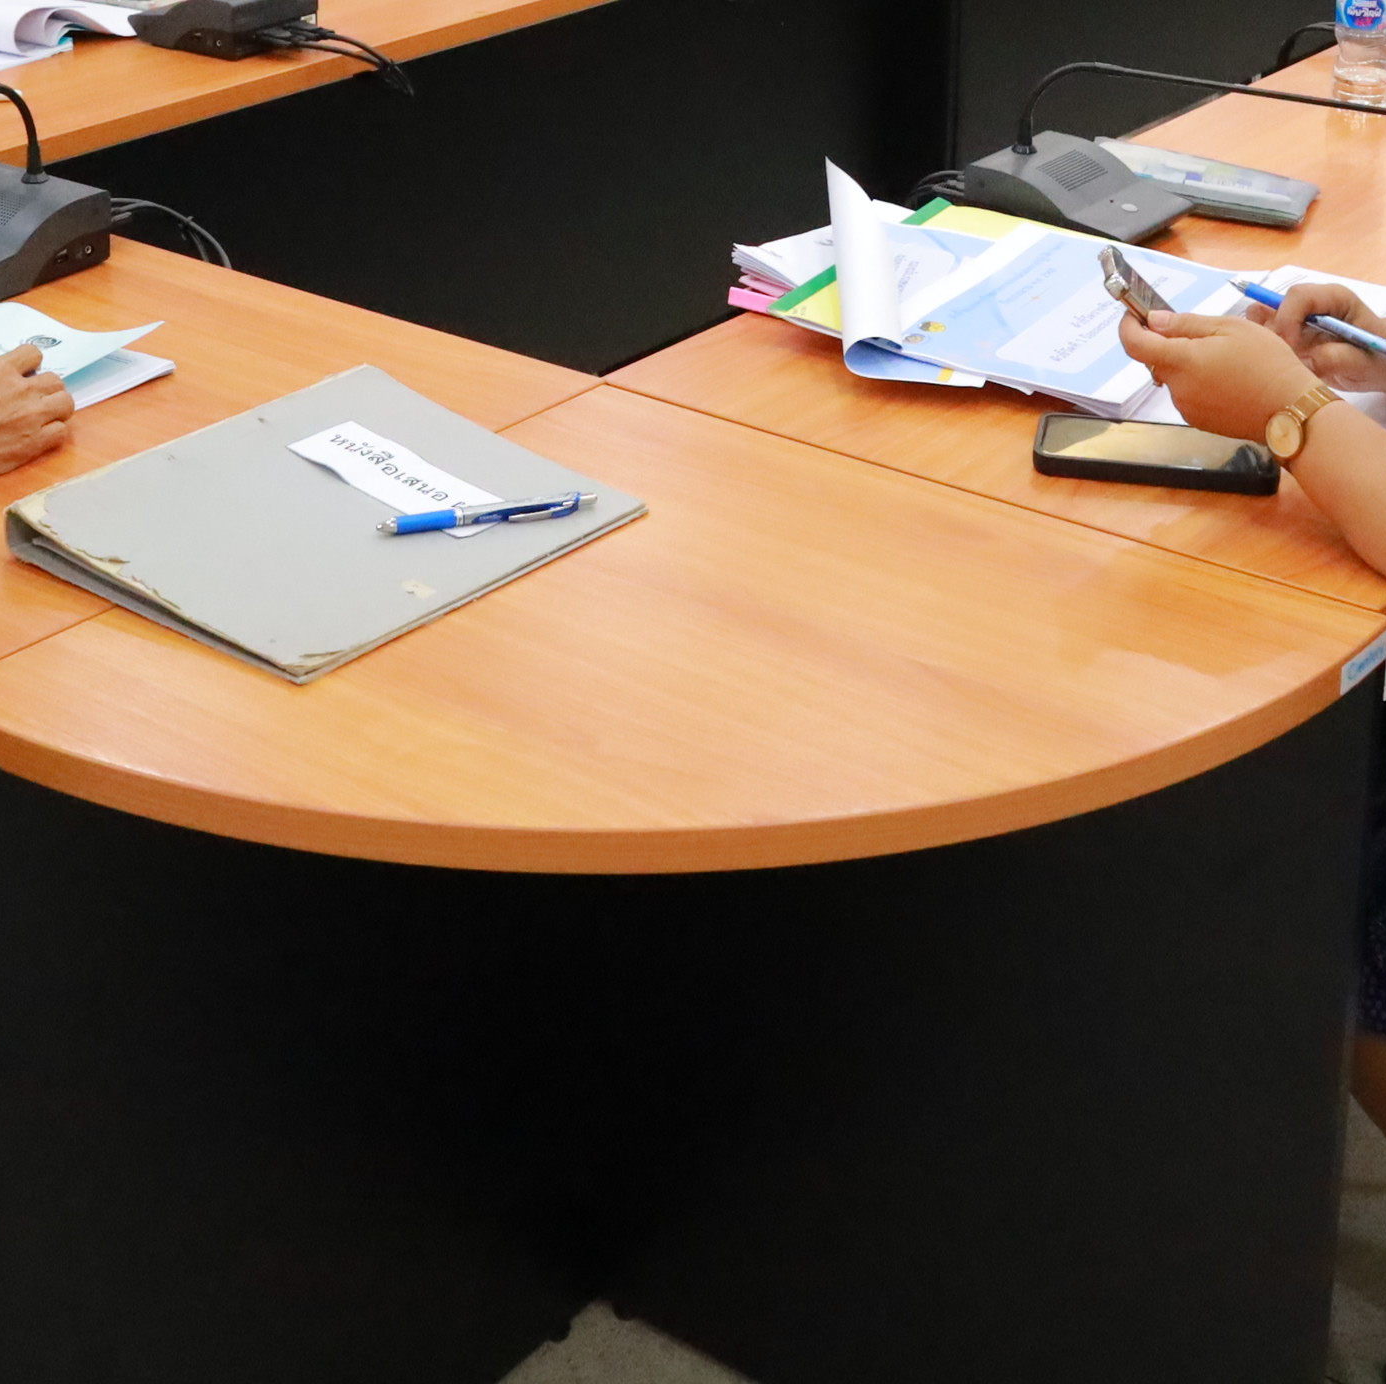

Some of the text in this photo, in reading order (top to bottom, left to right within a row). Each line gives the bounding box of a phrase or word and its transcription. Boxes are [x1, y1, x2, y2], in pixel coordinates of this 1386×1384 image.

[329, 433, 449, 503] หนังสือเสนอ
